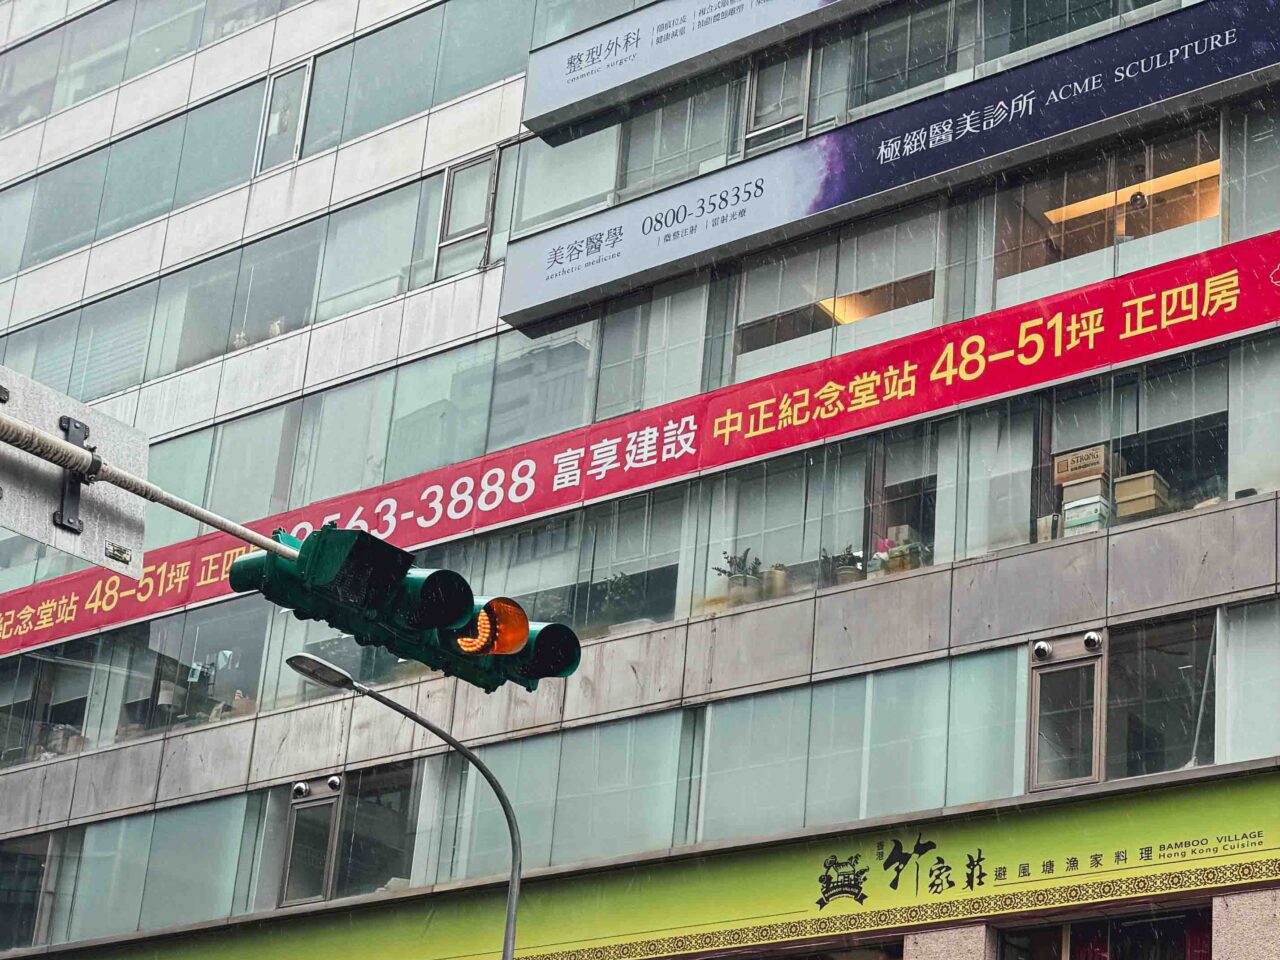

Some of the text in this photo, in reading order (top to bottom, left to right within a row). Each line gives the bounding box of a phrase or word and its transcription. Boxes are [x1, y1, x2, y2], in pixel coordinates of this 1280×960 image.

[565, 28, 640, 76] 整型外科
[606, 53, 638, 72] surgery
[1045, 28, 1238, 107] ACME SCULPTURE
[876, 90, 1037, 165] 極緻醫美診所
[641, 177, 765, 236] 0800-358358
[546, 225, 624, 270] 美容醫學
[546, 251, 621, 281] aesthetic medicine
[712, 268, 1241, 447] 中正紀念堂站 48-51坪 正四房
[551, 415, 697, 493] 富享建設
[993, 845, 1153, 882] 避風塘漁家料理
[1158, 830, 1264, 852] BAMBOO VILLAGE
[1158, 839, 1264, 860] Hong Kong Cuisine
